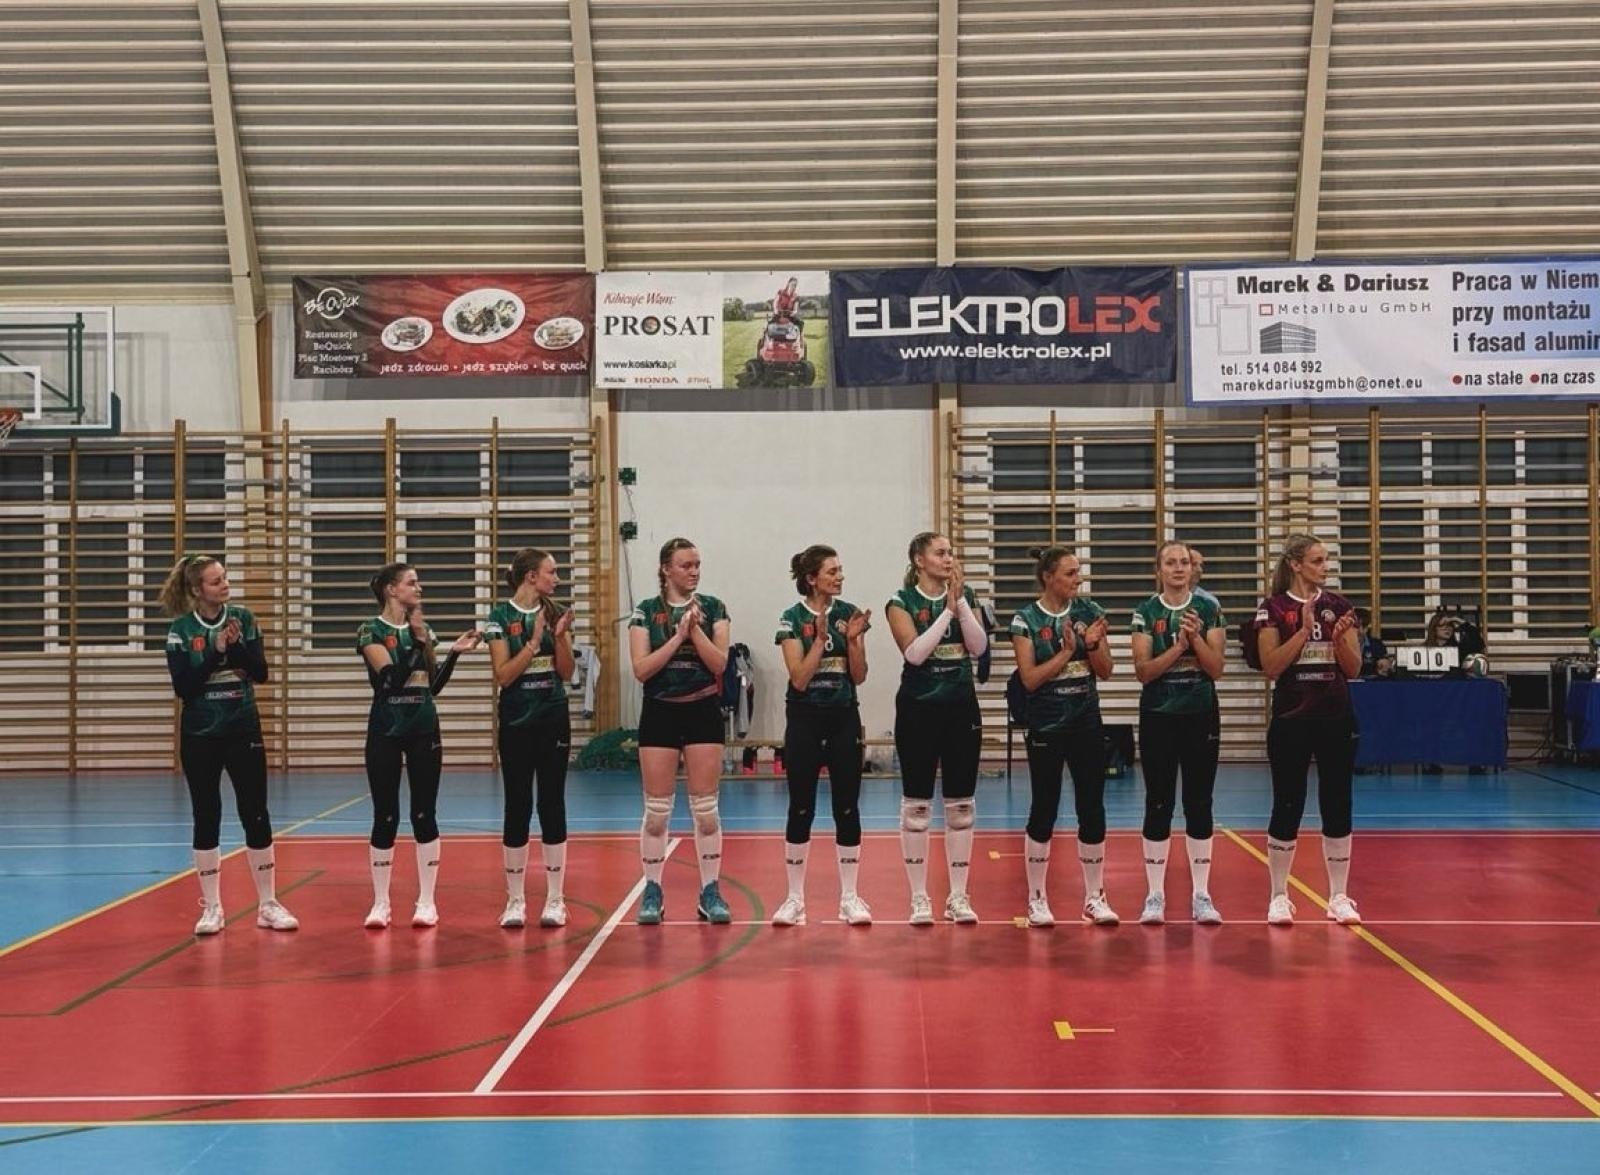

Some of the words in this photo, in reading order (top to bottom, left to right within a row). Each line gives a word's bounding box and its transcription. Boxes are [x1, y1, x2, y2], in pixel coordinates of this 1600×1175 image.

[1237, 274, 1309, 294] Marek
[1317, 274, 1335, 292] &
[1344, 273, 1429, 292] Dariusz
[1452, 271, 1512, 291] Praca
[1521, 274, 1537, 290] w
[847, 295, 1161, 337] ELEKTROLEX
[1278, 303, 1368, 314] Metallbau
[1380, 301, 1432, 313] GmbH
[1452, 305, 1494, 326] przy
[1503, 300, 1591, 321] montażu
[603, 315, 715, 336] PROSAT
[1453, 332, 1459, 352] i
[1468, 331, 1526, 352] fasad
[899, 342, 1112, 361] www.elektrolex.pl
[380, 363, 404, 374] jedz
[408, 363, 450, 373] zdrowo
[461, 363, 485, 374] jedz
[489, 361, 529, 373] szybko
[542, 360, 556, 371] be
[560, 360, 588, 373] quick
[1221, 363, 1241, 376] tel.
[1247, 361, 1269, 374] 514
[1273, 361, 1297, 374] 084
[1301, 360, 1322, 373] 992
[1223, 376, 1423, 393] marekdariuszgmbh@onet.eu
[1464, 373, 1482, 386] na
[1487, 370, 1523, 386] stałe
[1541, 372, 1558, 384] na
[1564, 371, 1596, 384] czas
[1312, 621, 1322, 641] 8
[1413, 651, 1422, 666] 0
[1435, 651, 1443, 667] 0
